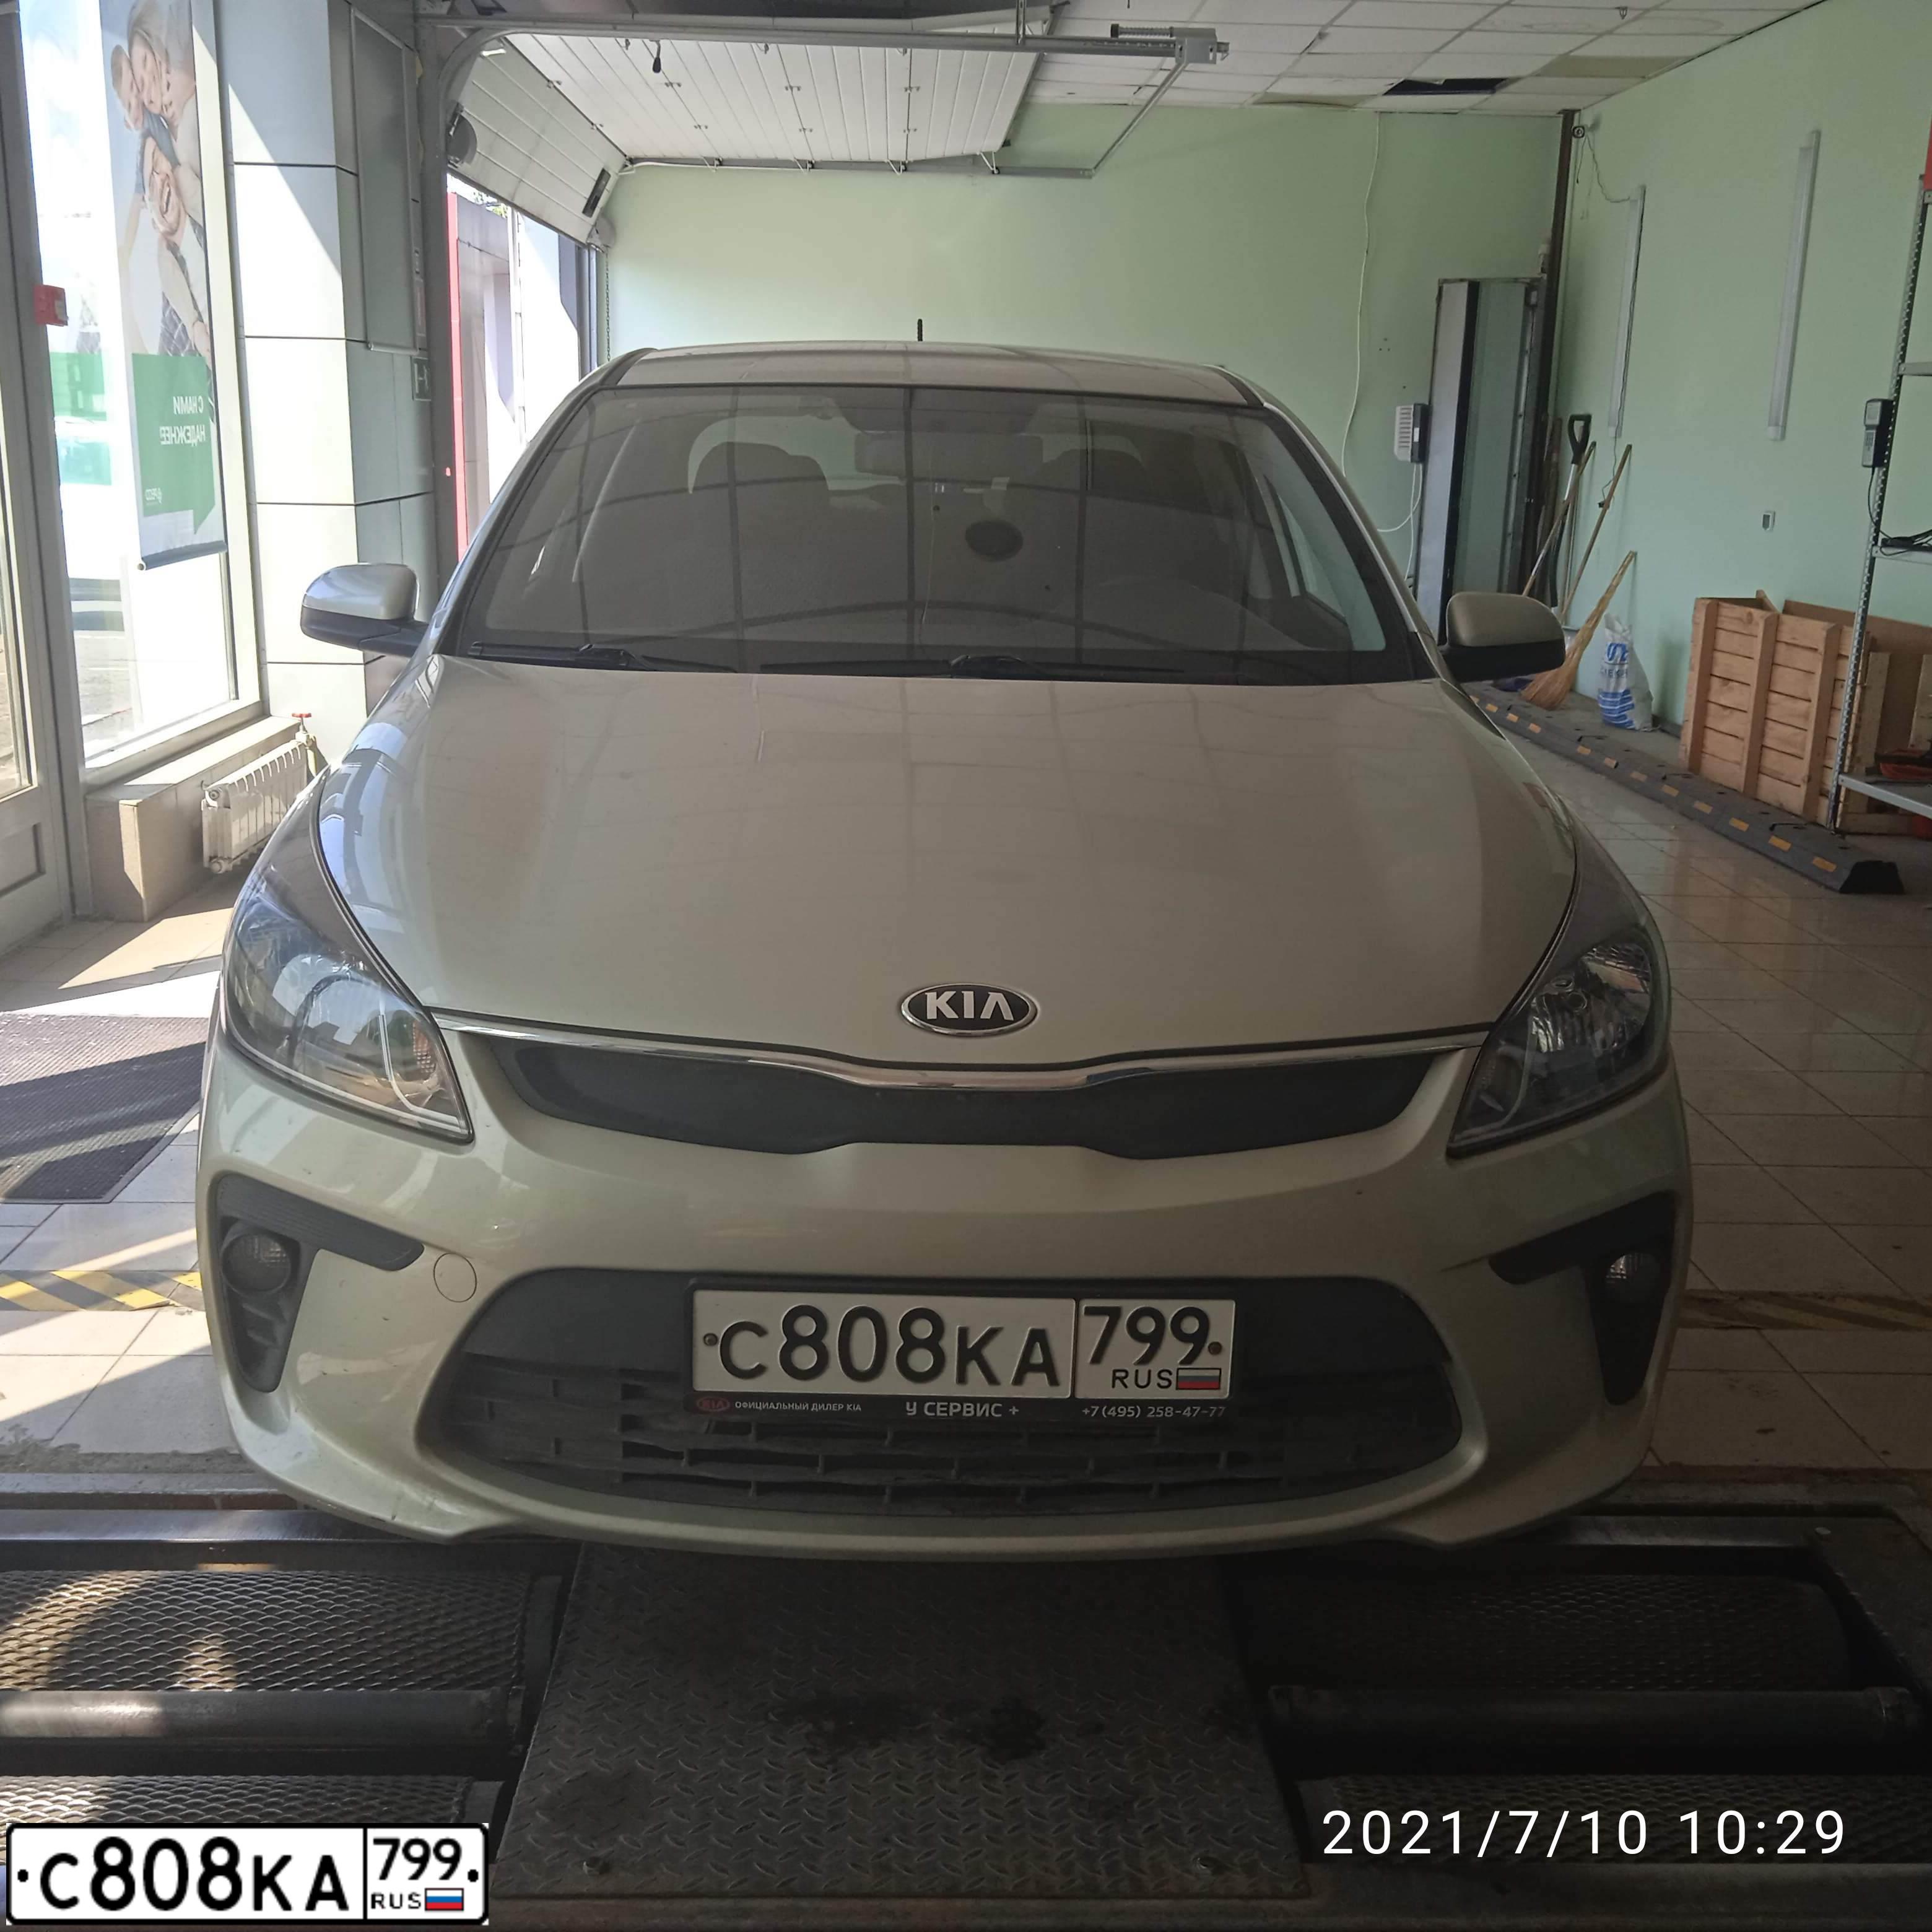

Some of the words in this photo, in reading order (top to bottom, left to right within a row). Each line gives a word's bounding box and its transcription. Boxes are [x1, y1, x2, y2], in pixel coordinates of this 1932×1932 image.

[925, 991, 1014, 1021] KIA
[718, 1303, 1060, 1386] С808КА
[1084, 1305, 1210, 1366] 799
[1112, 1368, 1173, 1389] RUS
[734, 1401, 809, 1411] ОФИЦИАЛЬНЫЙ
[811, 1403, 844, 1412] ДИЛЕР
[846, 1403, 862, 1412] KIA
[906, 1401, 917, 1416] У
[923, 1402, 1003, 1417] СЕРВИС
[1147, 1406, 1227, 1417] 258-47-77
